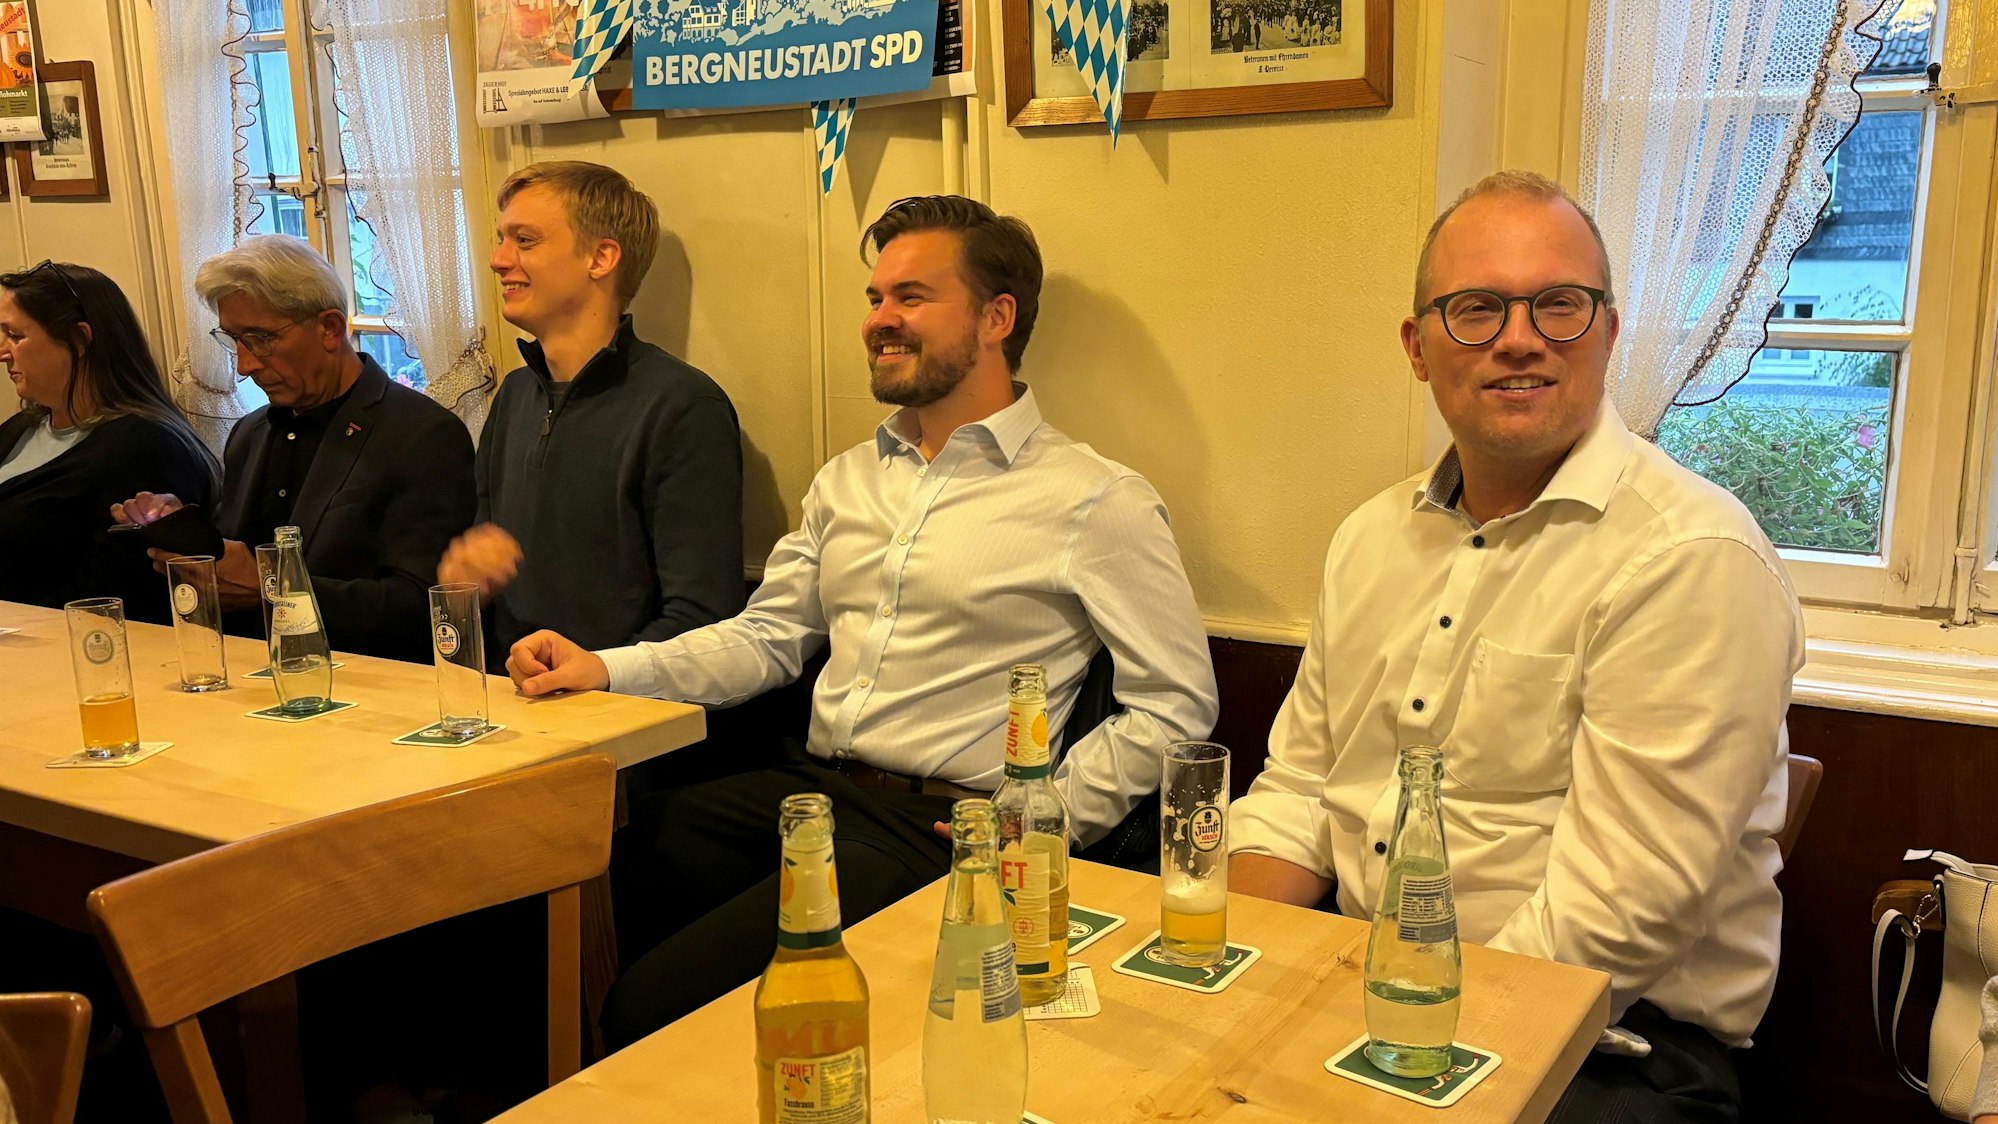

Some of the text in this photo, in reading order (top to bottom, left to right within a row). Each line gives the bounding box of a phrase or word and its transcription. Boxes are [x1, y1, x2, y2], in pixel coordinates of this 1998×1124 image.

[0, 7, 25, 29] eustadt
[646, 38, 866, 86] BERGNEUSTADT
[870, 30, 923, 68] SPD
[508, 88, 542, 99] Spezialangebot
[1006, 709, 1019, 757] ZUNFT
[1195, 820, 1219, 836] Zunft
[781, 1063, 816, 1077] ZUNFT
